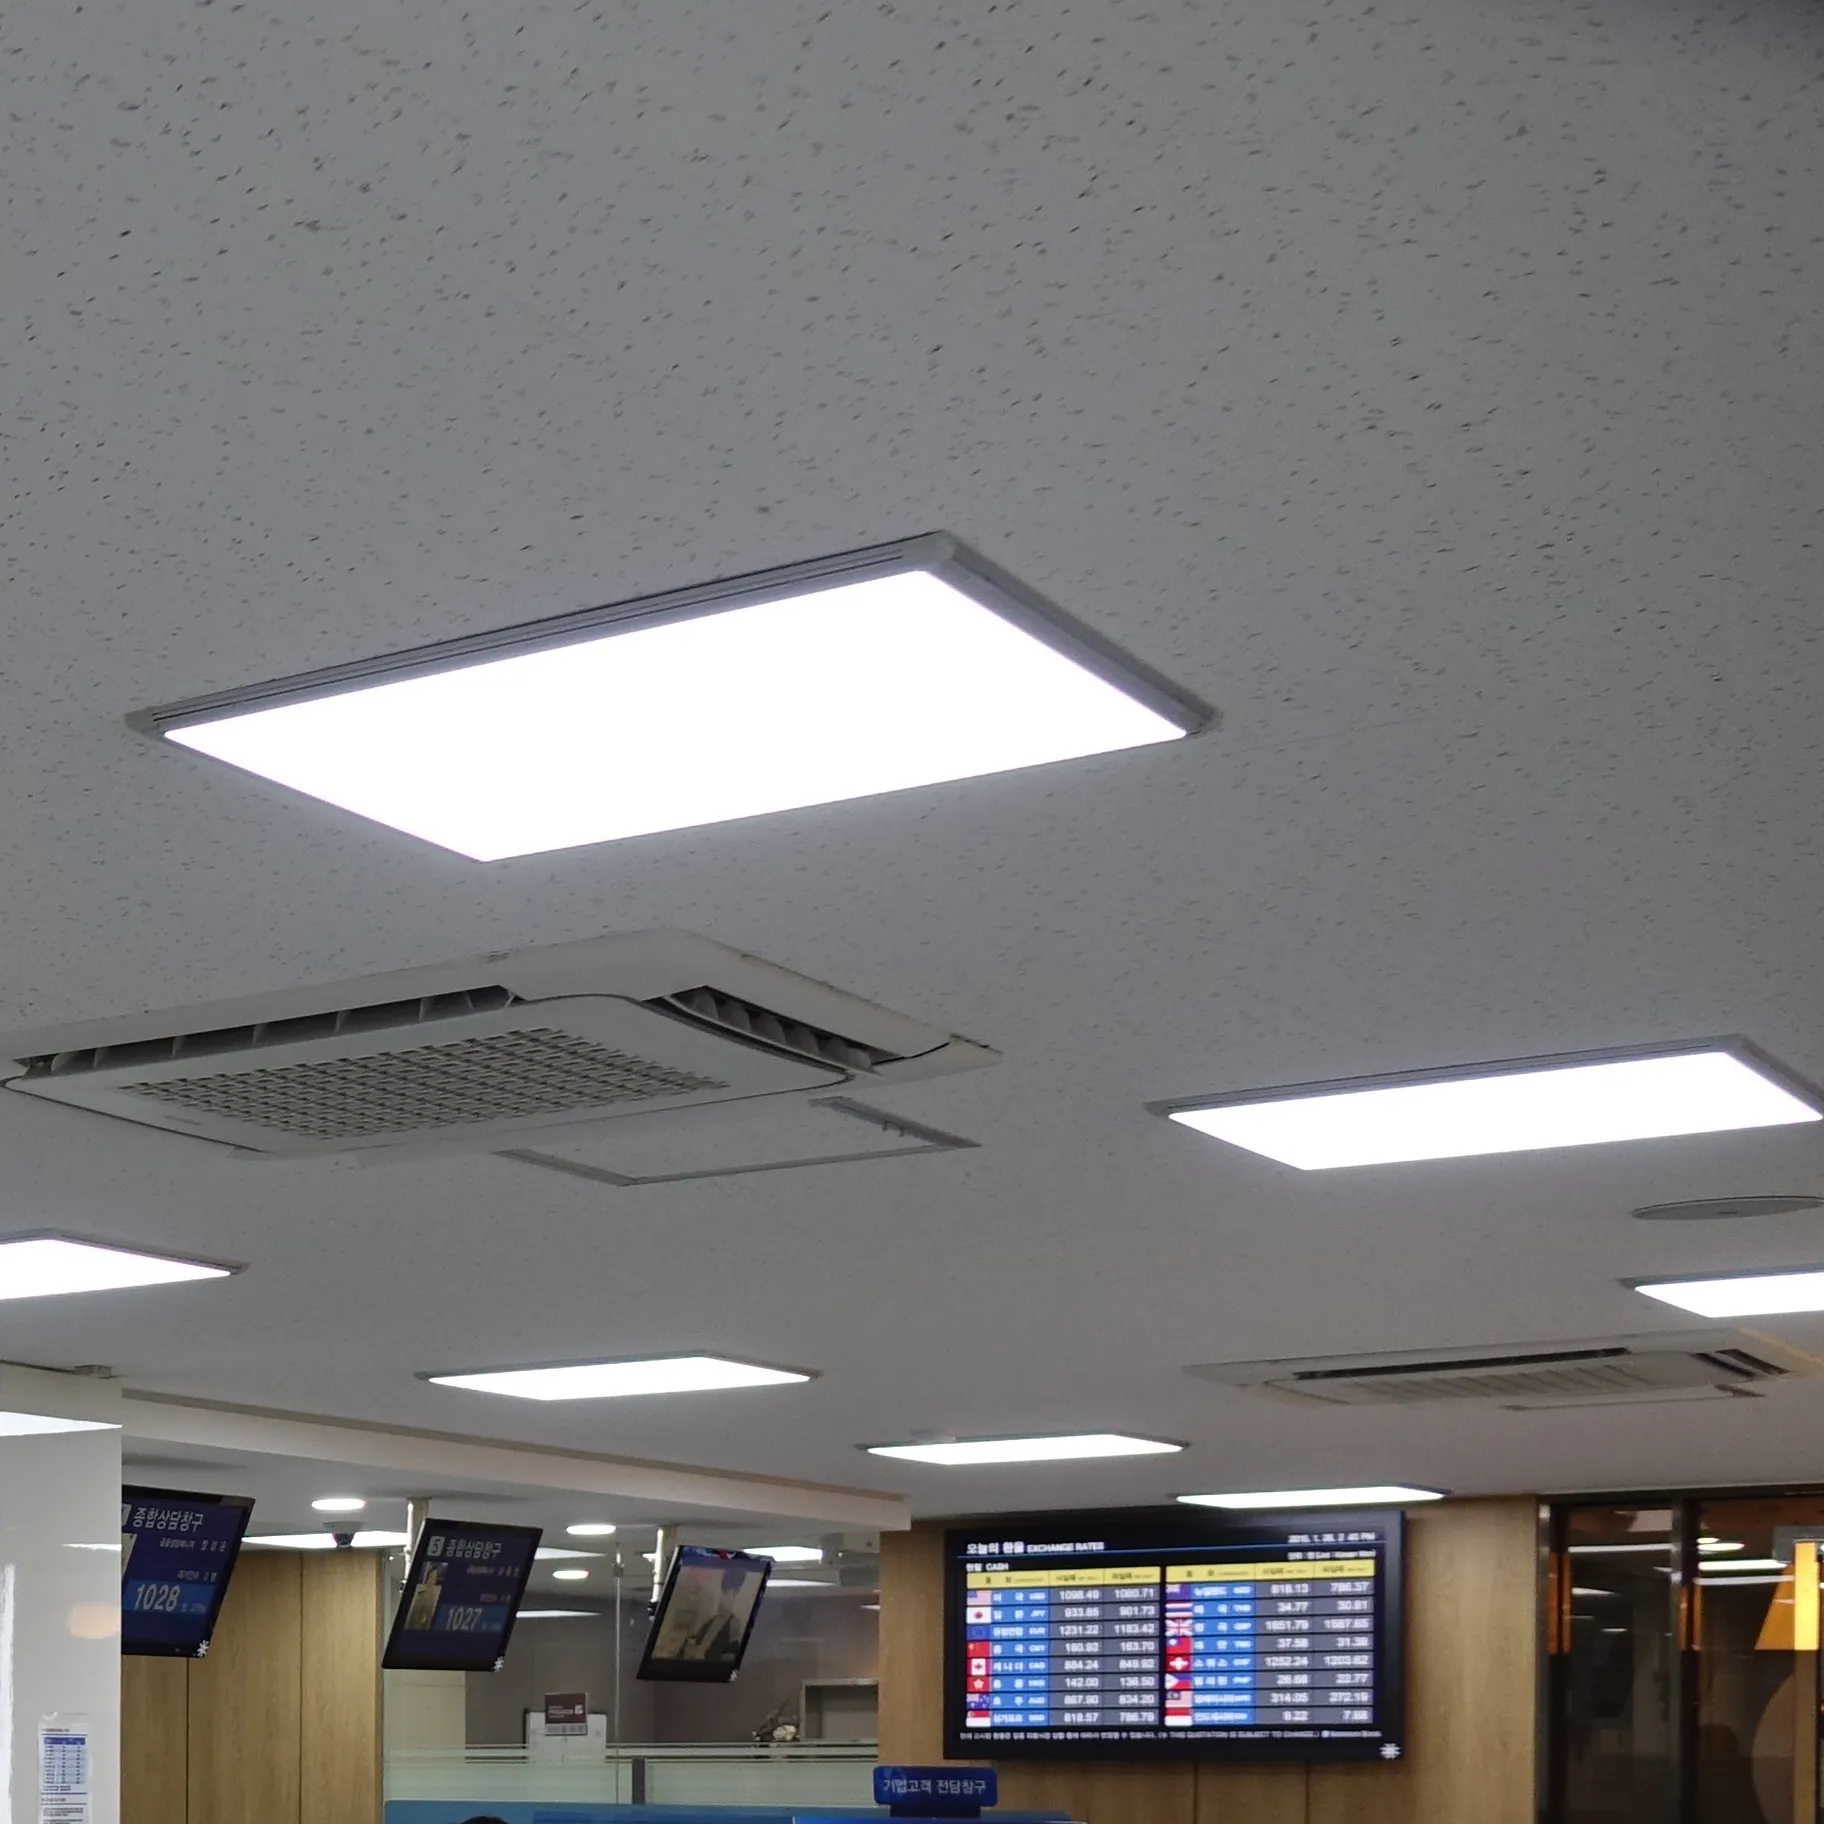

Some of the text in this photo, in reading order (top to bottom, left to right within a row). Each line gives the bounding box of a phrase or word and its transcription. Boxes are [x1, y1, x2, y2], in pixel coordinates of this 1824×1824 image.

[133, 1507, 204, 1532] 종합상담창구
[1027, 1543, 1074, 1553] EXCHANGE
[1075, 1541, 1105, 1551] RATES
[985, 1562, 1009, 1572] CASH
[134, 1584, 180, 1612] 1028
[446, 1607, 483, 1630] 1027
[883, 1779, 987, 1795] 기업고객 전담창구
